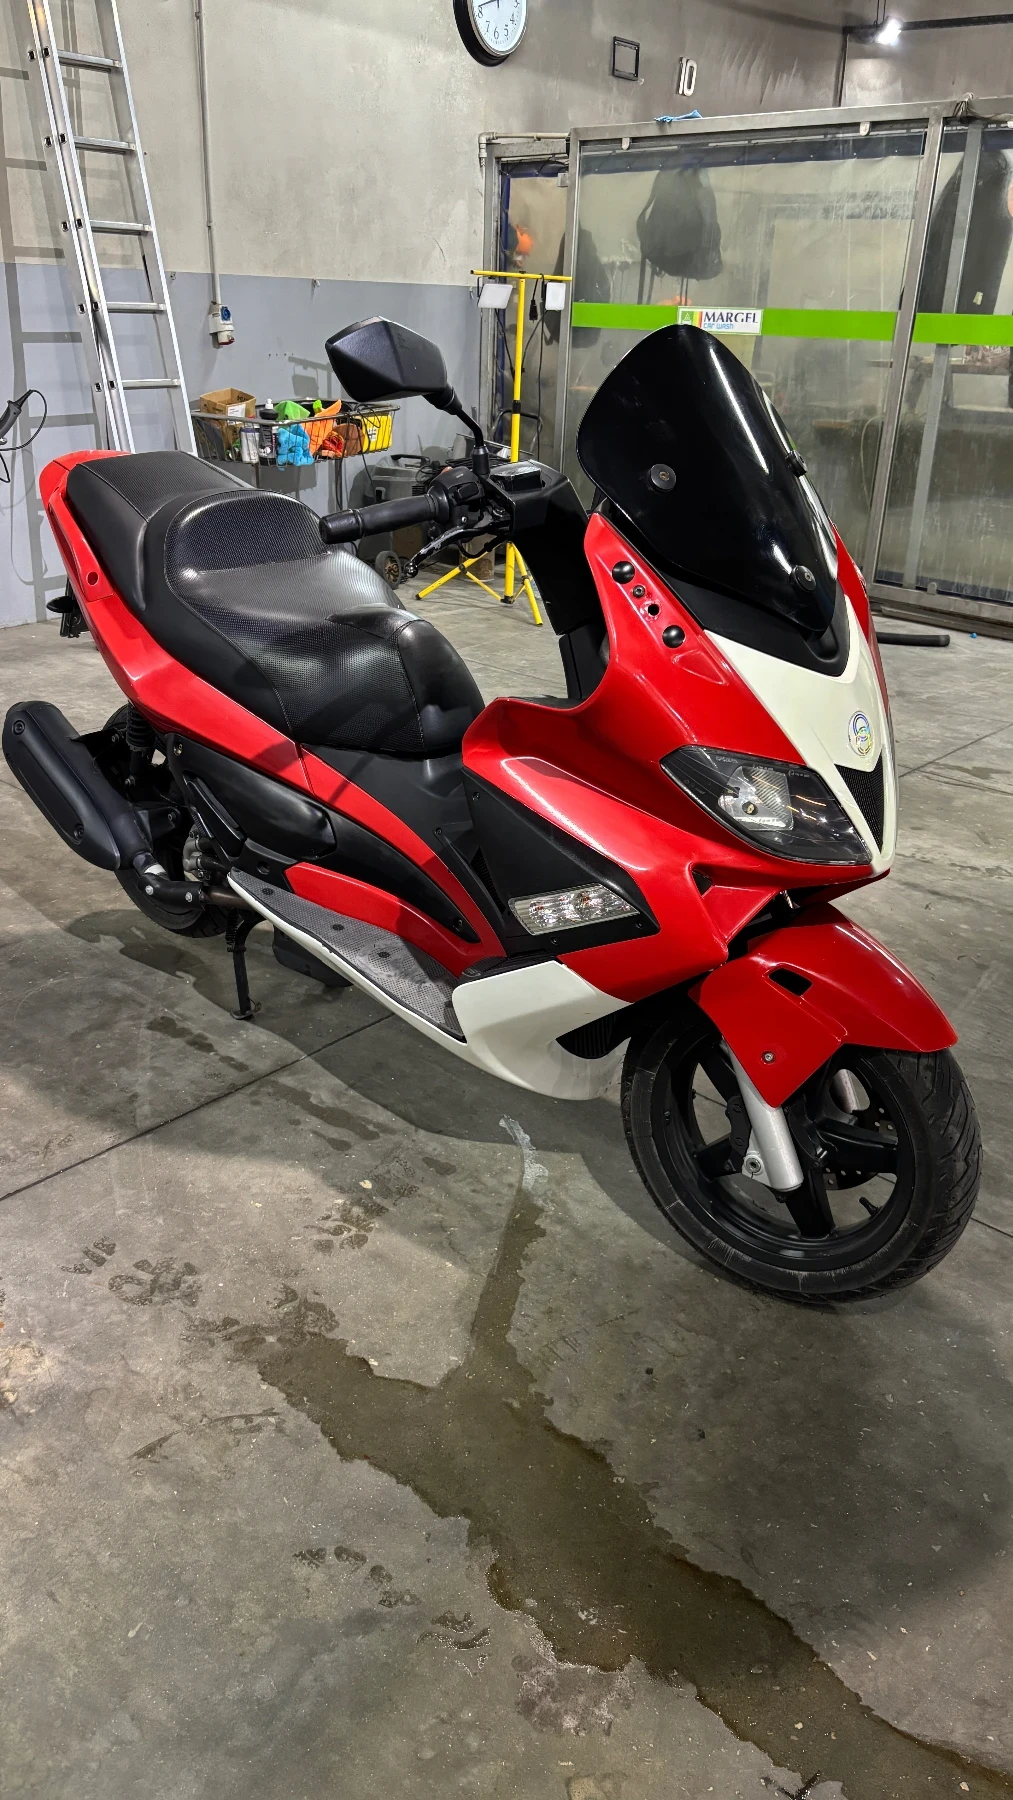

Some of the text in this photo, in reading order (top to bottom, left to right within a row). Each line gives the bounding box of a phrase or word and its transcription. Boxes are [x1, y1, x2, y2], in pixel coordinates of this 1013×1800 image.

[478, 6, 484, 19] 8
[485, 20, 491, 32] 7
[503, 24, 509, 37] 5
[493, 26, 500, 40] 6
[677, 56, 697, 96] 10
